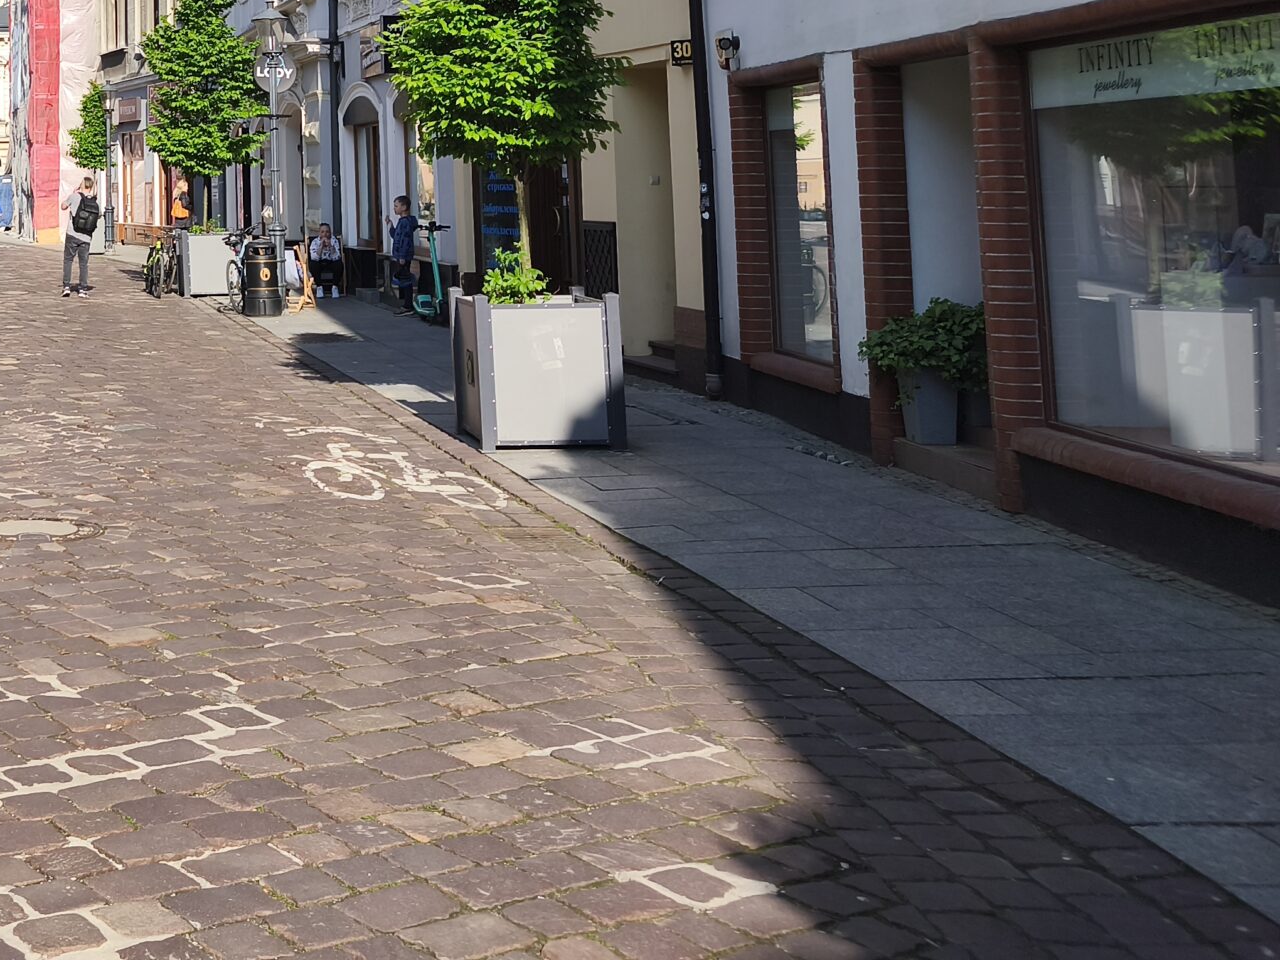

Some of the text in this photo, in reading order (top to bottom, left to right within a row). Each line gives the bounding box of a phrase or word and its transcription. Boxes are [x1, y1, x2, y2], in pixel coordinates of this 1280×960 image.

[673, 41, 692, 58] 30
[1078, 36, 1154, 73] INFINITY
[1194, 18, 1280, 59] INFINIT
[1093, 70, 1142, 99] jewellery
